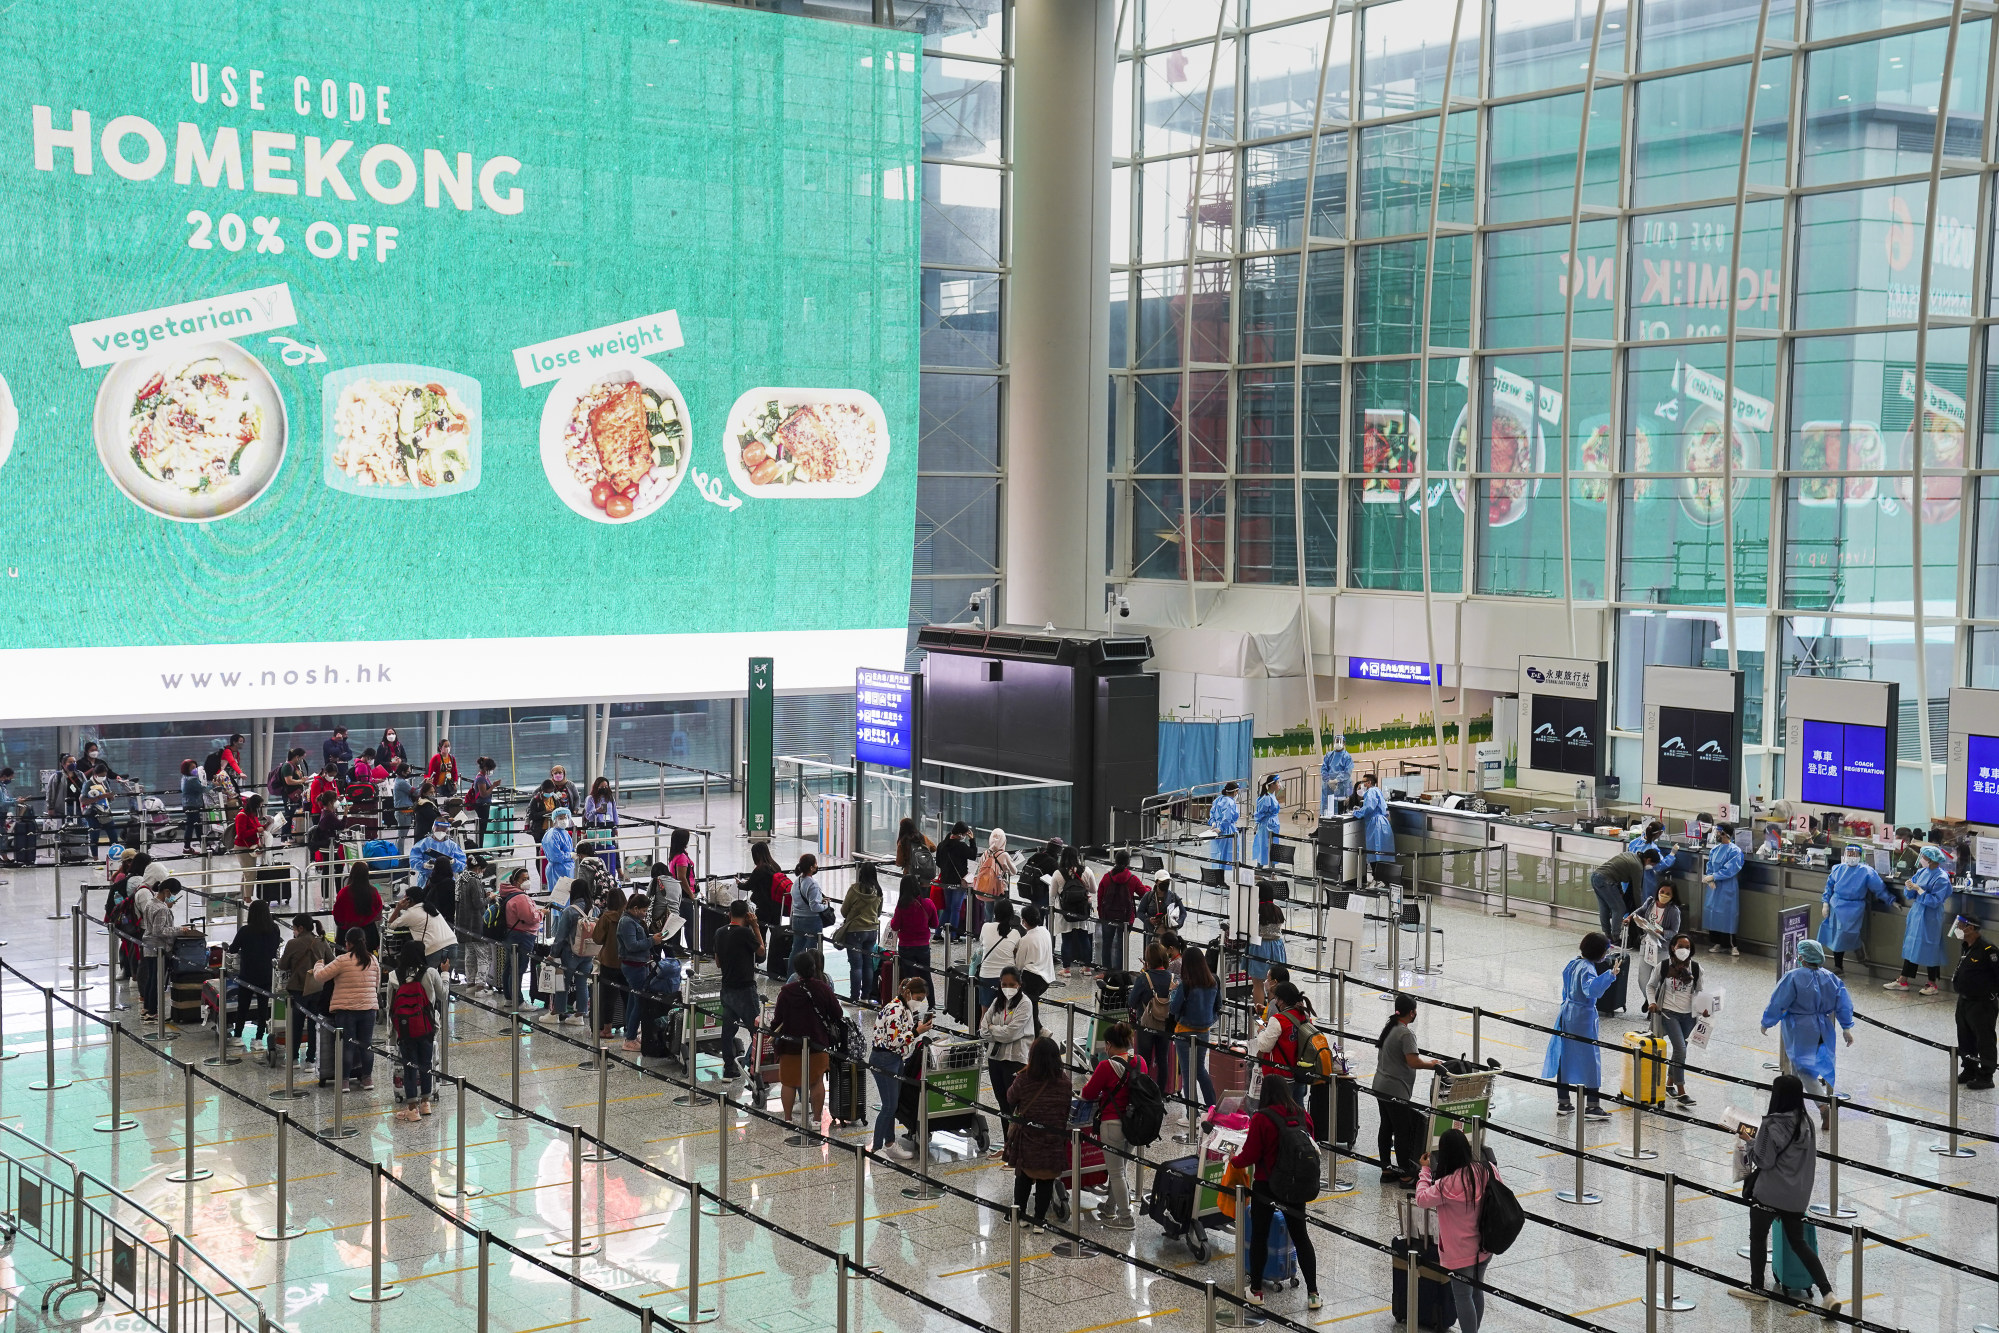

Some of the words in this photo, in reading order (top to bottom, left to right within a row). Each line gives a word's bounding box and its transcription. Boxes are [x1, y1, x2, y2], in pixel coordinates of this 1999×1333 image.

[191, 61, 266, 111] USE
[294, 75, 392, 126] CODE
[32, 104, 525, 216] HOMEKONG
[186, 209, 285, 255] 20%
[305, 220, 400, 264] OFF
[92, 306, 253, 352] vegetarian
[530, 349, 581, 374] lose
[586, 323, 664, 359] weight
[8, 566, 19, 578] u
[160, 663, 393, 689] www.nosh.hk
[1546, 668, 1590, 683] 永東旅行社
[1648, 711, 1656, 730] M02
[886, 731, 900, 746] 1,4
[1791, 724, 1799, 745] M03
[1812, 750, 1833, 762] 專車
[1953, 740, 1962, 762] M04
[1807, 762, 1838, 777] 登記處
[1844, 765, 1885, 775] REGISTRATION
[1854, 760, 1875, 768] COACH
[1644, 797, 1652, 808] 4
[1720, 806, 1727, 818] 3
[1800, 816, 1807, 829] 2
[1883, 827, 1890, 840] 1
[113, 846, 121, 858] 2
